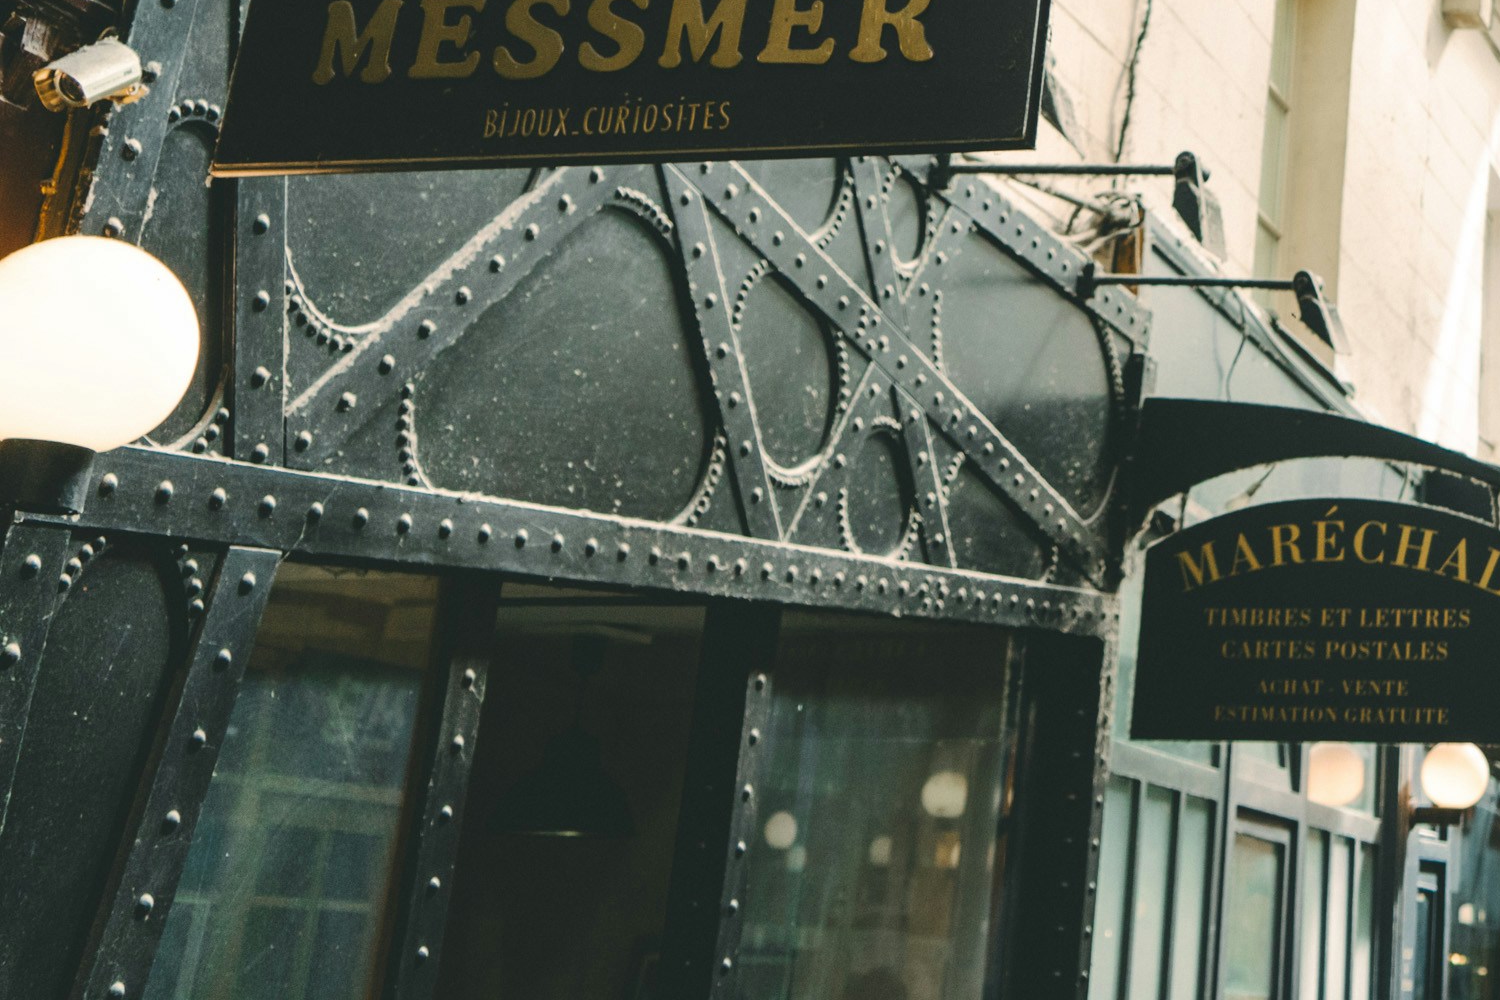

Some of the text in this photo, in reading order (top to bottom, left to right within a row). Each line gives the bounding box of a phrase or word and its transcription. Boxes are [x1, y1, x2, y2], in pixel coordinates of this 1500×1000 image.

[1204, 607, 1472, 629] TIMBRES ET LETTRES
[1221, 640, 1450, 662] CARTES POSTALES
[1257, 679, 1324, 697] ACHAT
[1342, 679, 1409, 696] VENTE
[1214, 704, 1449, 726] ESTIMATION GRATUITE
